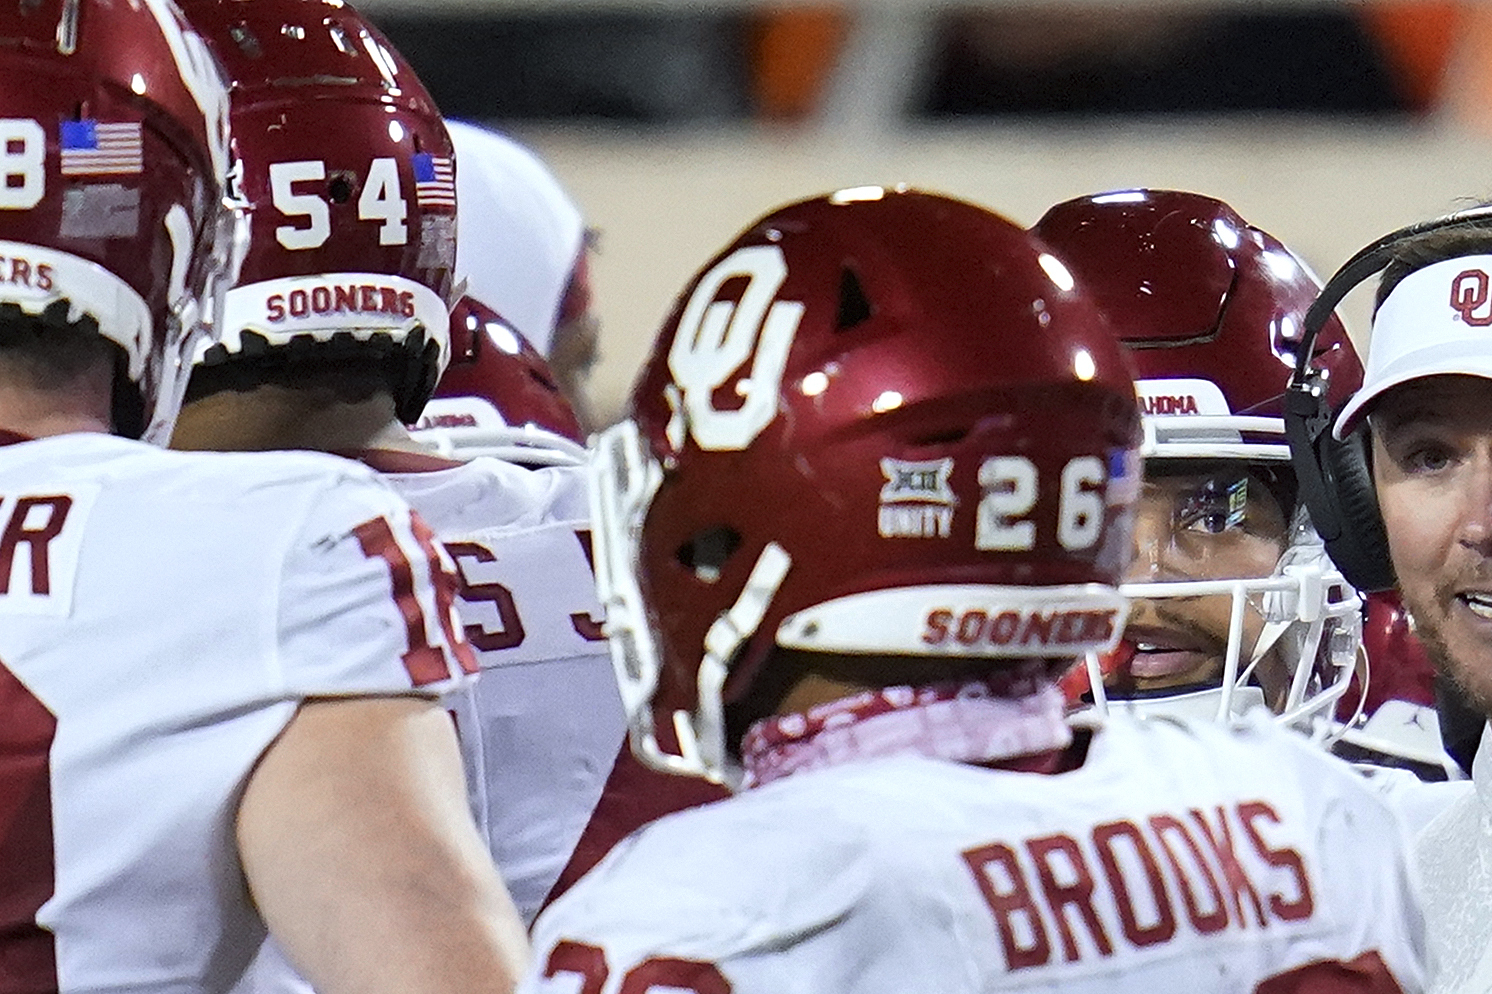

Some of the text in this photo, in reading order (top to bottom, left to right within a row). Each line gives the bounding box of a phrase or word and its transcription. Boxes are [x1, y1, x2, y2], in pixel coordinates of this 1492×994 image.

[269, 157, 408, 250] 54
[266, 284, 415, 323] SOONERS
[668, 247, 805, 452] OU
[0, 496, 73, 595] R
[975, 455, 1107, 550] 26
[921, 608, 1119, 645] SOONERS
[961, 800, 1317, 971] BROOKS
